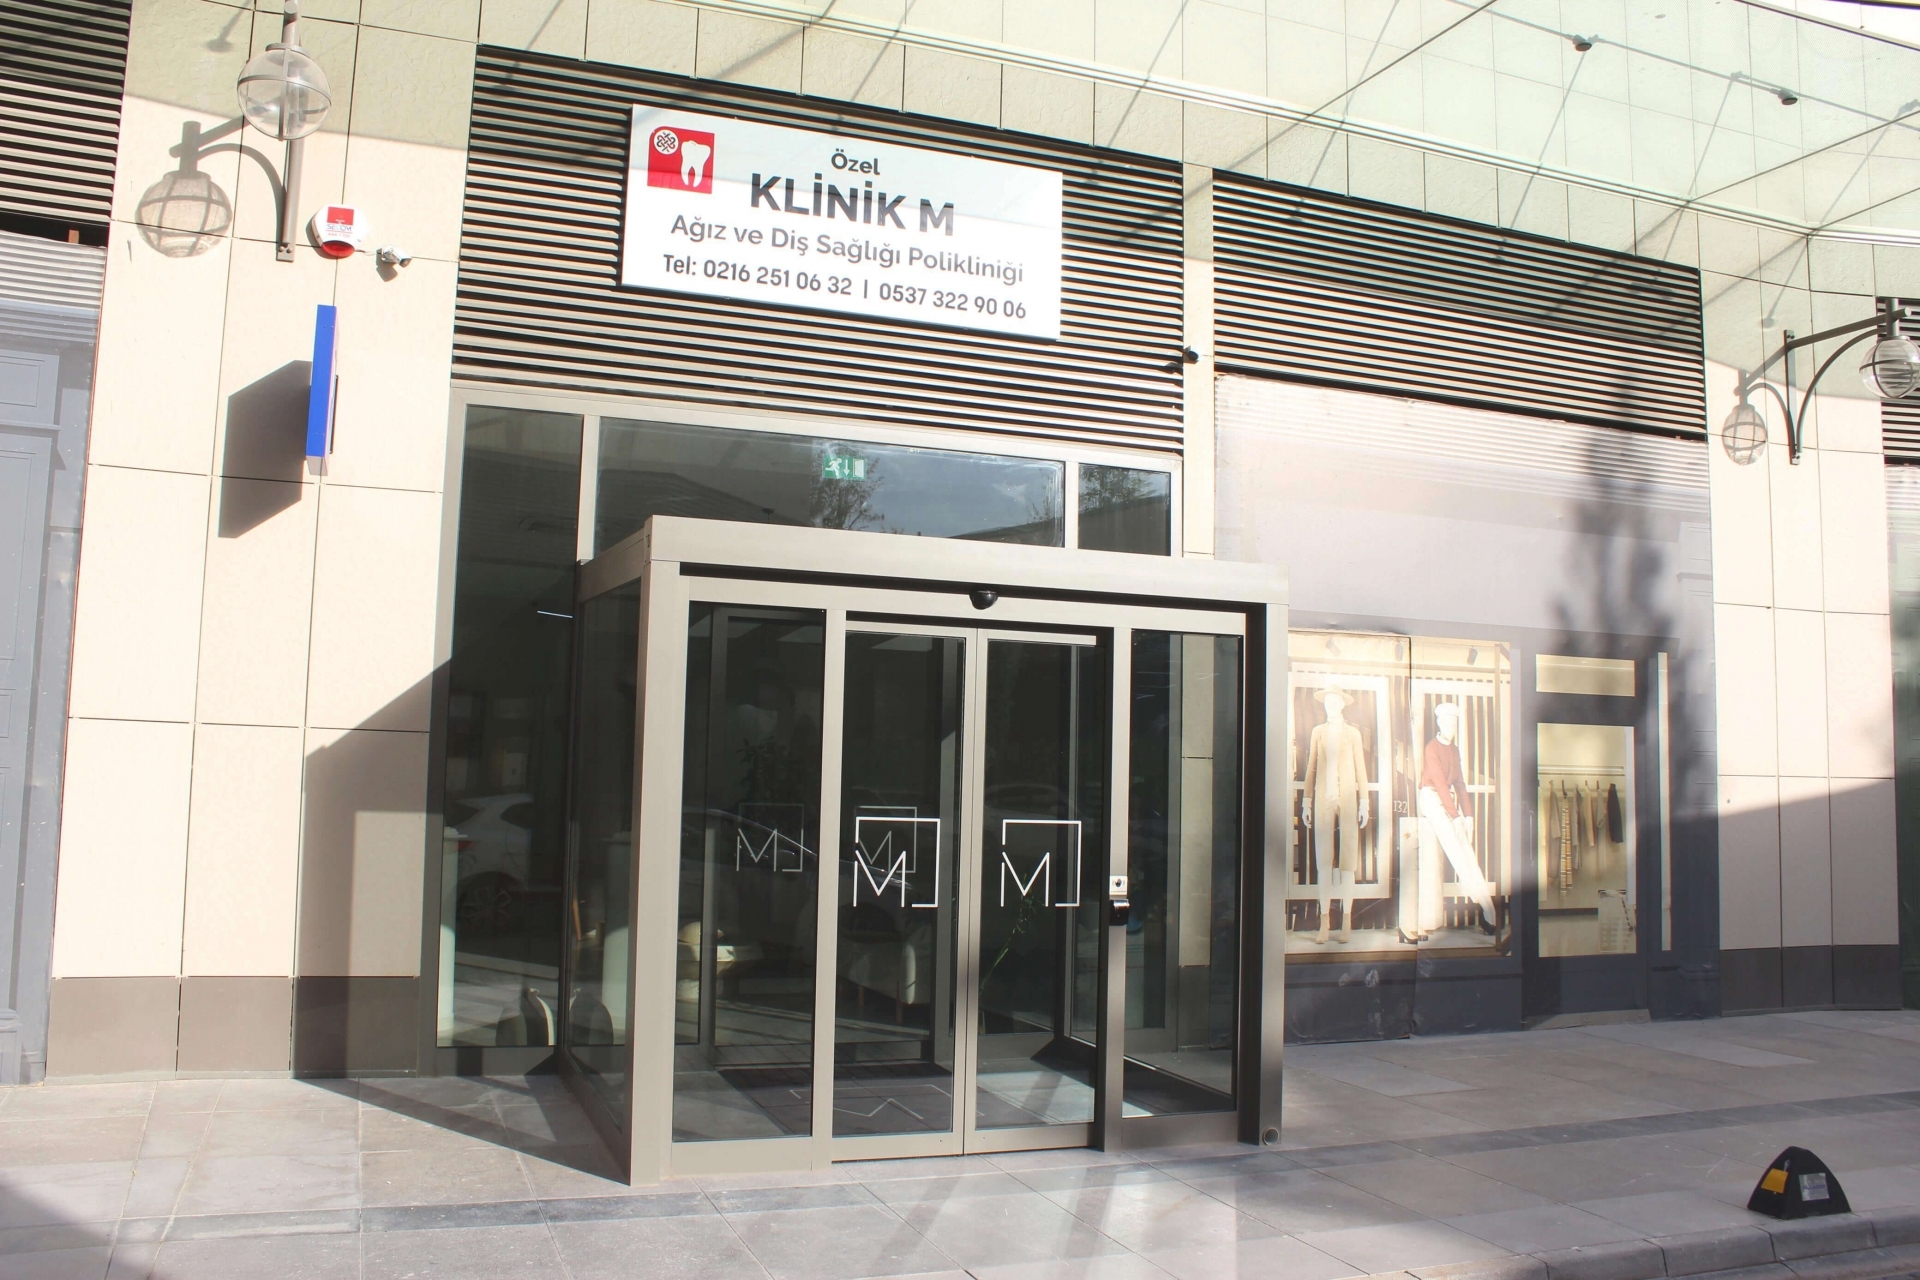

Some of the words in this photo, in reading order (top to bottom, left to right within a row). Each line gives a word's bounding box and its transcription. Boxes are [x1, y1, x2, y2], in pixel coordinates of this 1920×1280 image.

[831, 148, 880, 175] Özel
[751, 173, 907, 229] KLİNİK
[919, 198, 955, 236] M
[671, 214, 727, 242] Ağız
[733, 227, 763, 245] ve
[771, 227, 809, 256] Diş
[816, 234, 901, 269] Sağlığı
[908, 246, 1023, 286] Polikliniği
[663, 254, 697, 276] Tel:
[703, 259, 750, 283] 0216
[756, 266, 790, 288] 251
[796, 271, 822, 291] 06
[827, 275, 853, 296] 32
[879, 282, 927, 306] 0537
[932, 290, 969, 311] 322
[974, 295, 998, 316] 90
[1003, 300, 1026, 319] 06
[1393, 800, 1408, 813] 132
